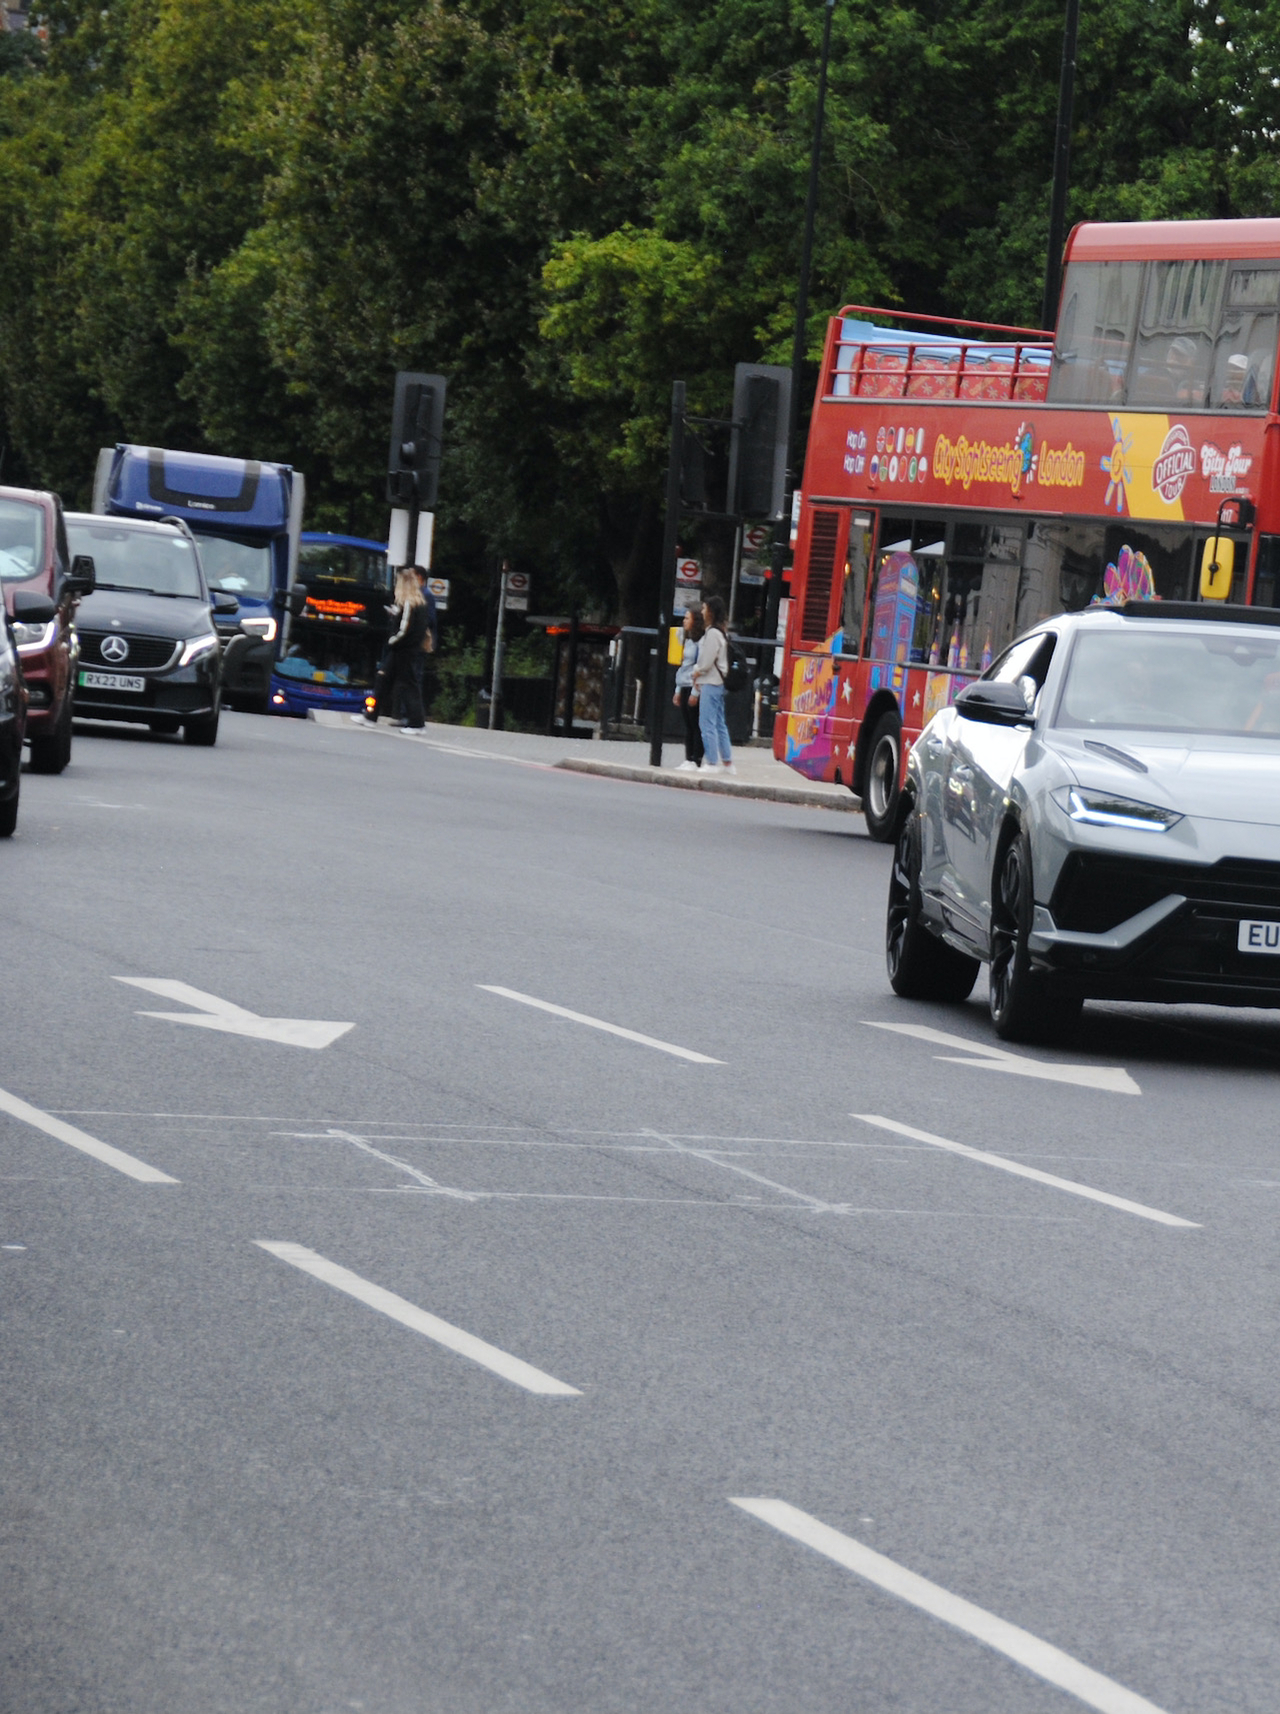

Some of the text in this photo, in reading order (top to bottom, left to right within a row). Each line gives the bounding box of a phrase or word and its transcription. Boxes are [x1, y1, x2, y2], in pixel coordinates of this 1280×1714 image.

[846, 430, 867, 450] Hop On
[844, 454, 865, 473] Hop Off
[1038, 440, 1086, 487] London
[1156, 451, 1193, 484] OFFICIAL
[1201, 445, 1252, 477] City Tour
[1165, 478, 1183, 498] TOUR
[86, 674, 142, 689] RX22 UNS
